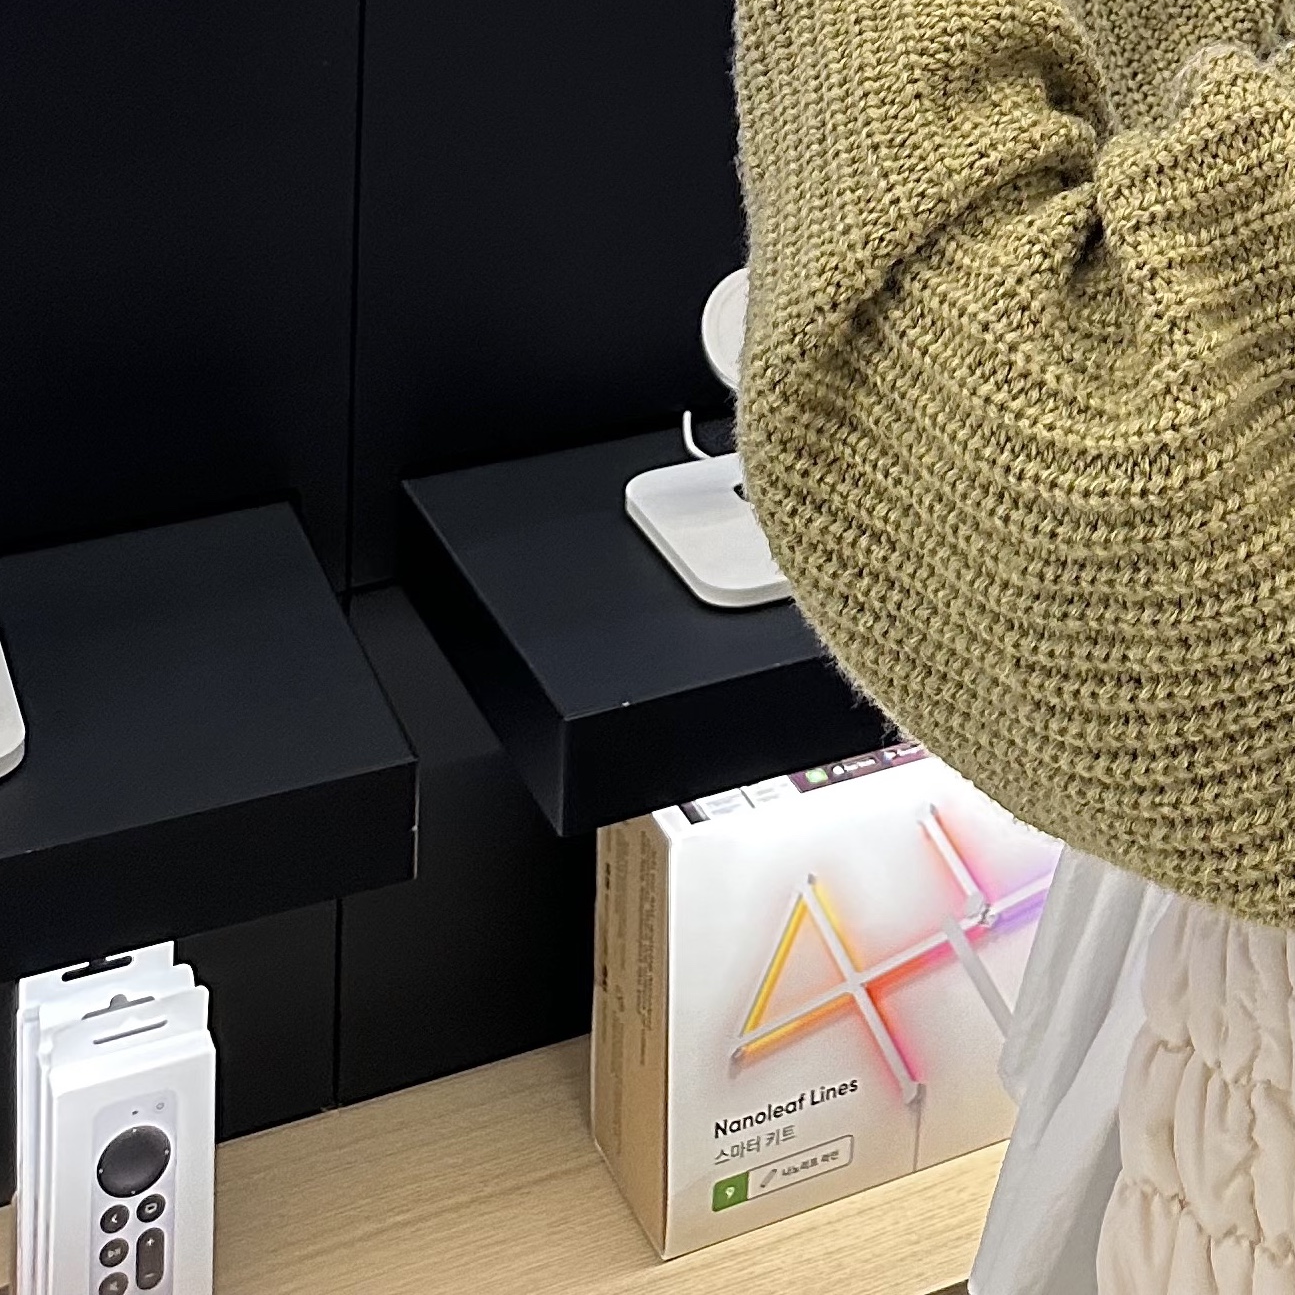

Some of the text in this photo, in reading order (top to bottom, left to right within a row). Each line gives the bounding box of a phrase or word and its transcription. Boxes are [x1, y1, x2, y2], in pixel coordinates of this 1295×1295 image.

[714, 1078, 859, 1139] Nanoleaf Lines
[714, 1124, 797, 1166] 스마터 키트
